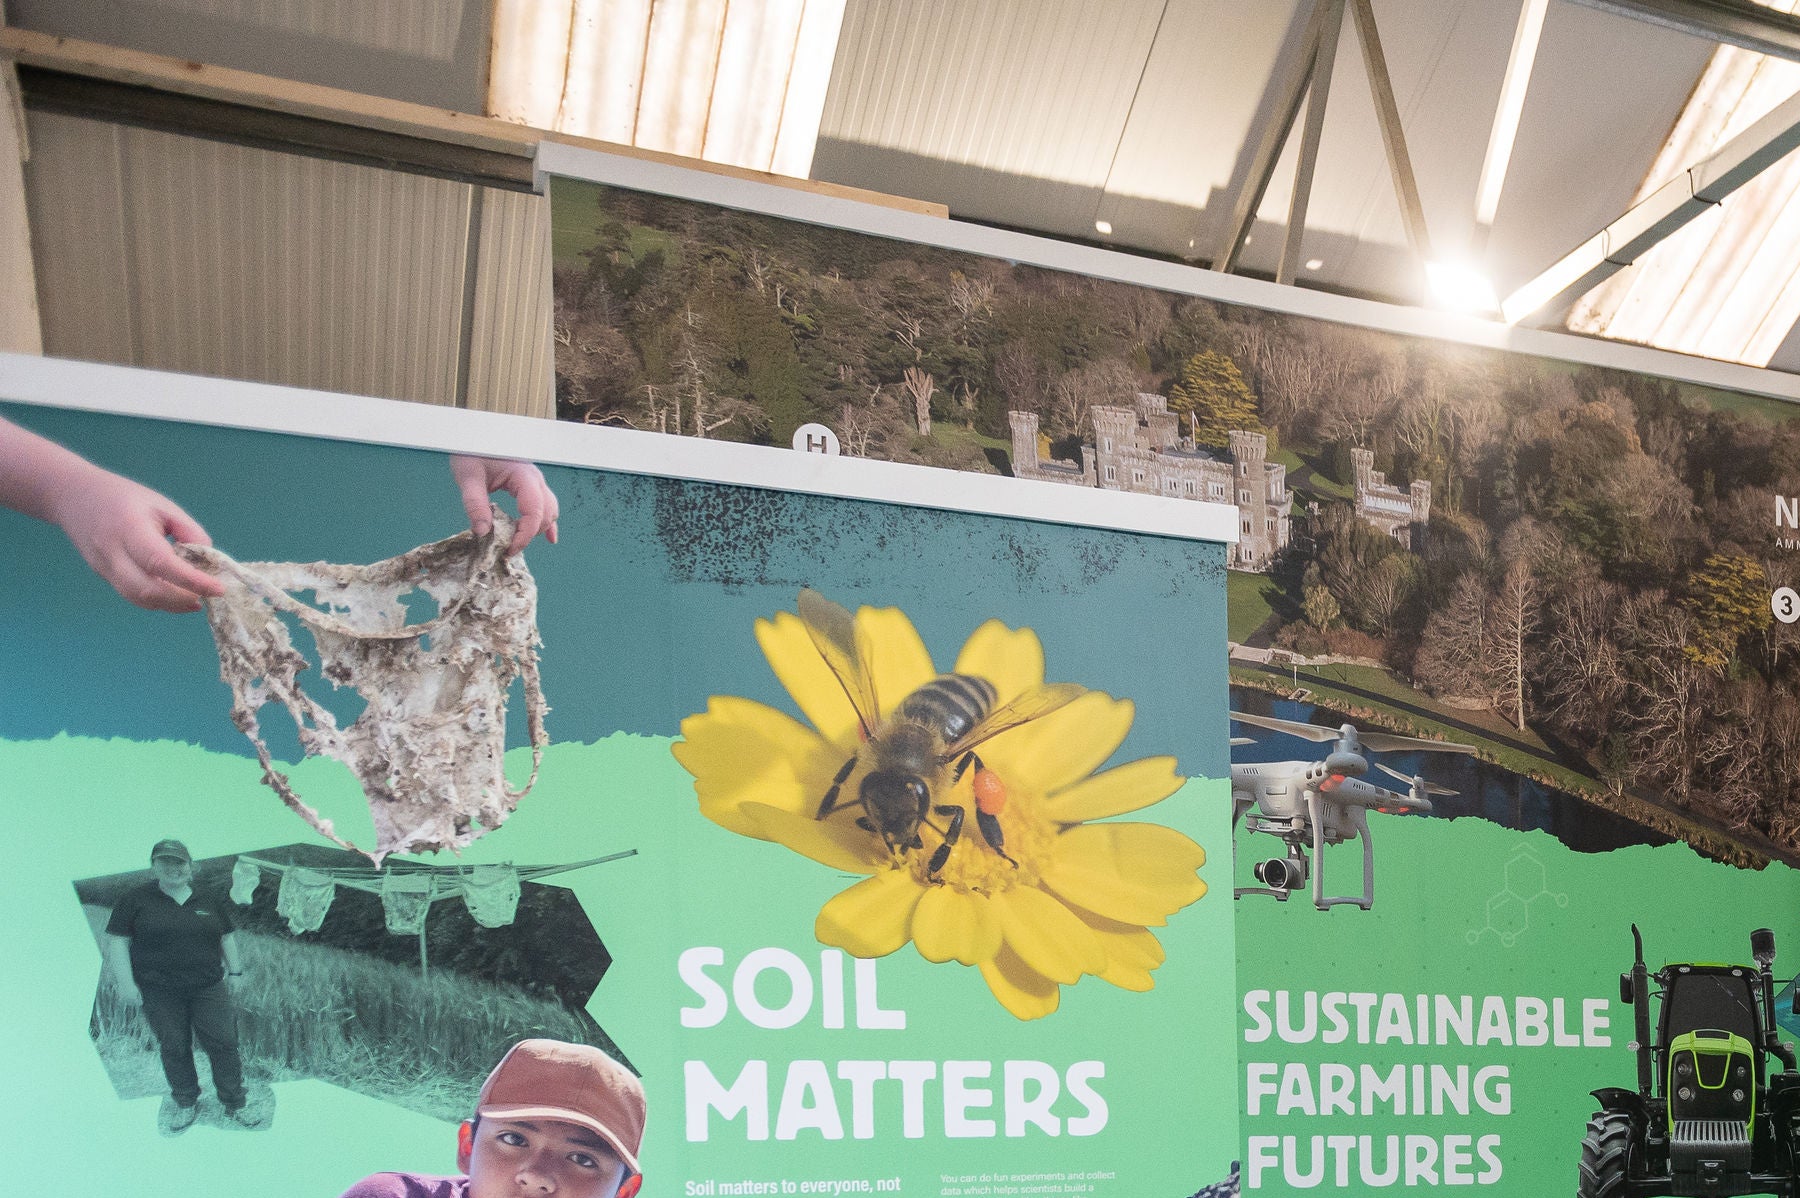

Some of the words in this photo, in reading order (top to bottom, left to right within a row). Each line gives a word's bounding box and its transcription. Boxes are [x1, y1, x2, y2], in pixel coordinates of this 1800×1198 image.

[1780, 595, 1793, 616] 3
[677, 946, 907, 1030] SOIL
[1243, 990, 1612, 1048] SUSTAINABLE
[683, 1060, 1109, 1142] MATTERS
[1246, 1063, 1512, 1116] FARMING
[685, 1180, 714, 1195] Soil
[719, 1180, 777, 1194] matters
[780, 1179, 796, 1193] to
[800, 1180, 872, 1195] everyone,
[877, 1177, 900, 1190] not
[1248, 1134, 1502, 1189] FUTURES
